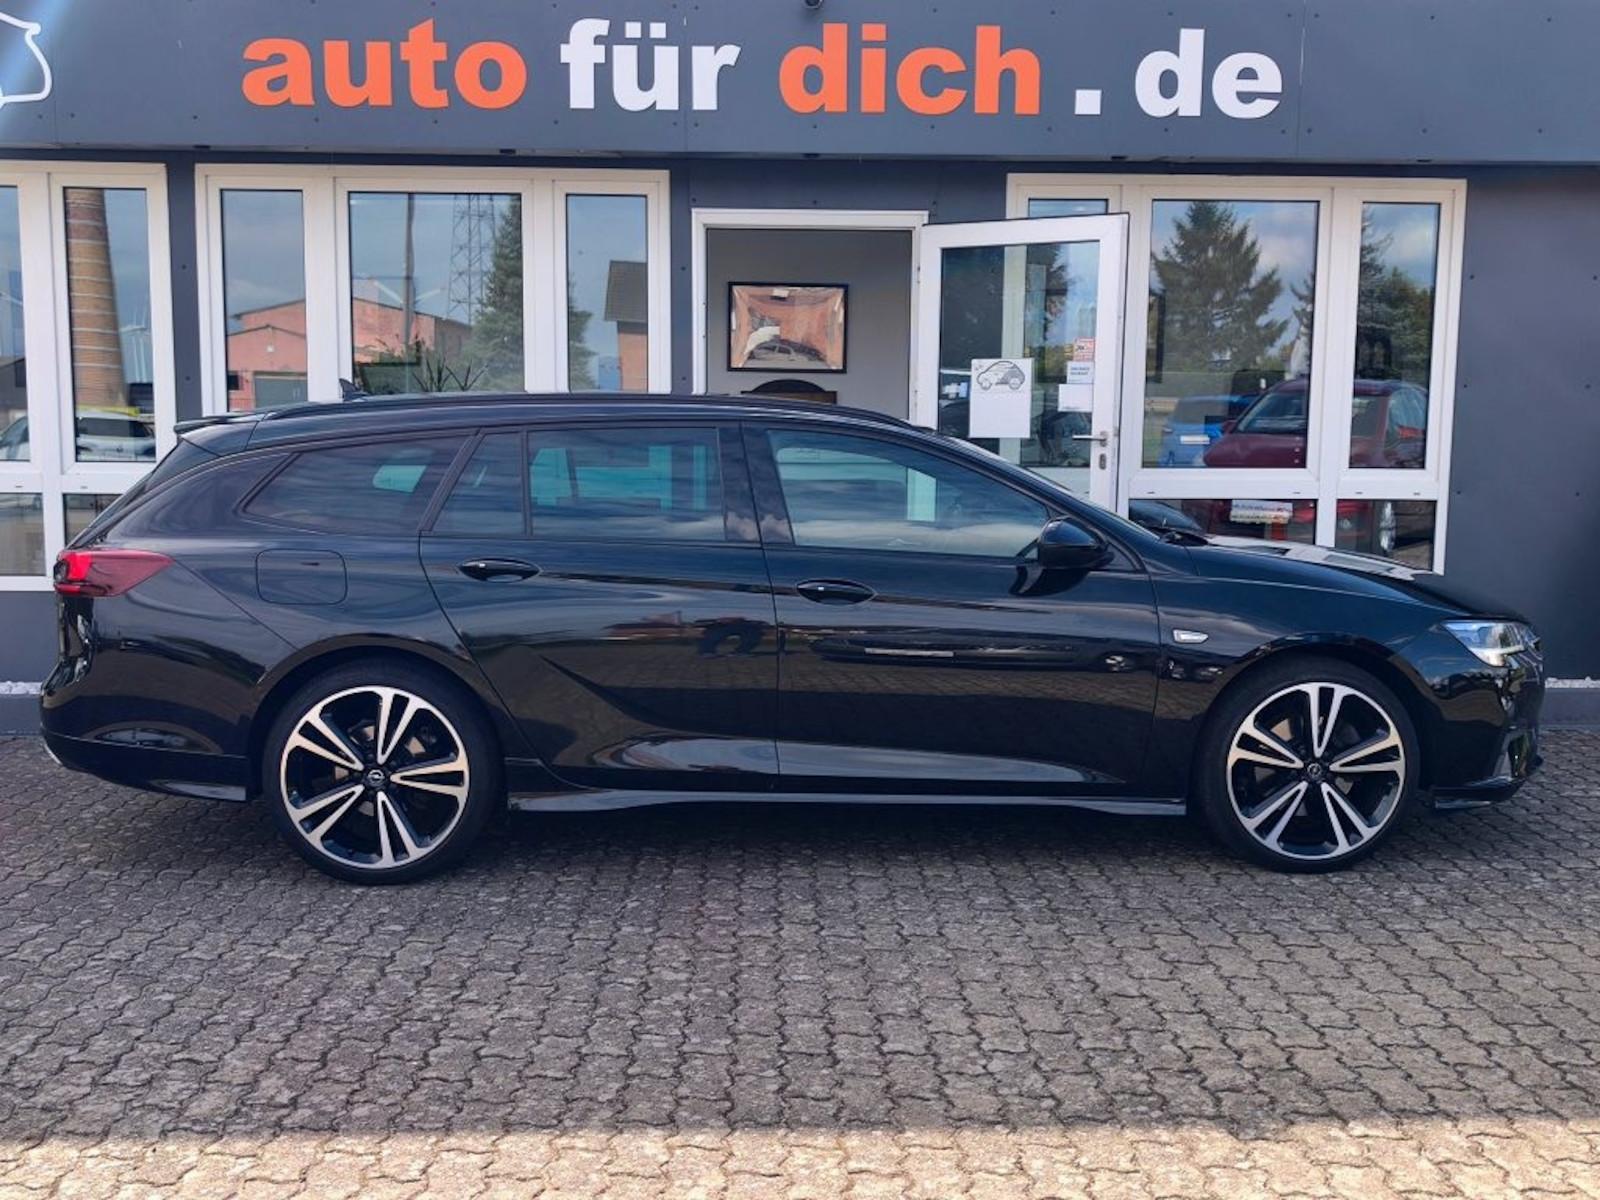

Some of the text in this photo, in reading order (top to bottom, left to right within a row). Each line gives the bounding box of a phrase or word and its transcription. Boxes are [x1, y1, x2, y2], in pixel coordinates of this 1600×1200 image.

[242, 20, 527, 109] auto
[560, 18, 741, 111] für
[779, 23, 1041, 115] dich
